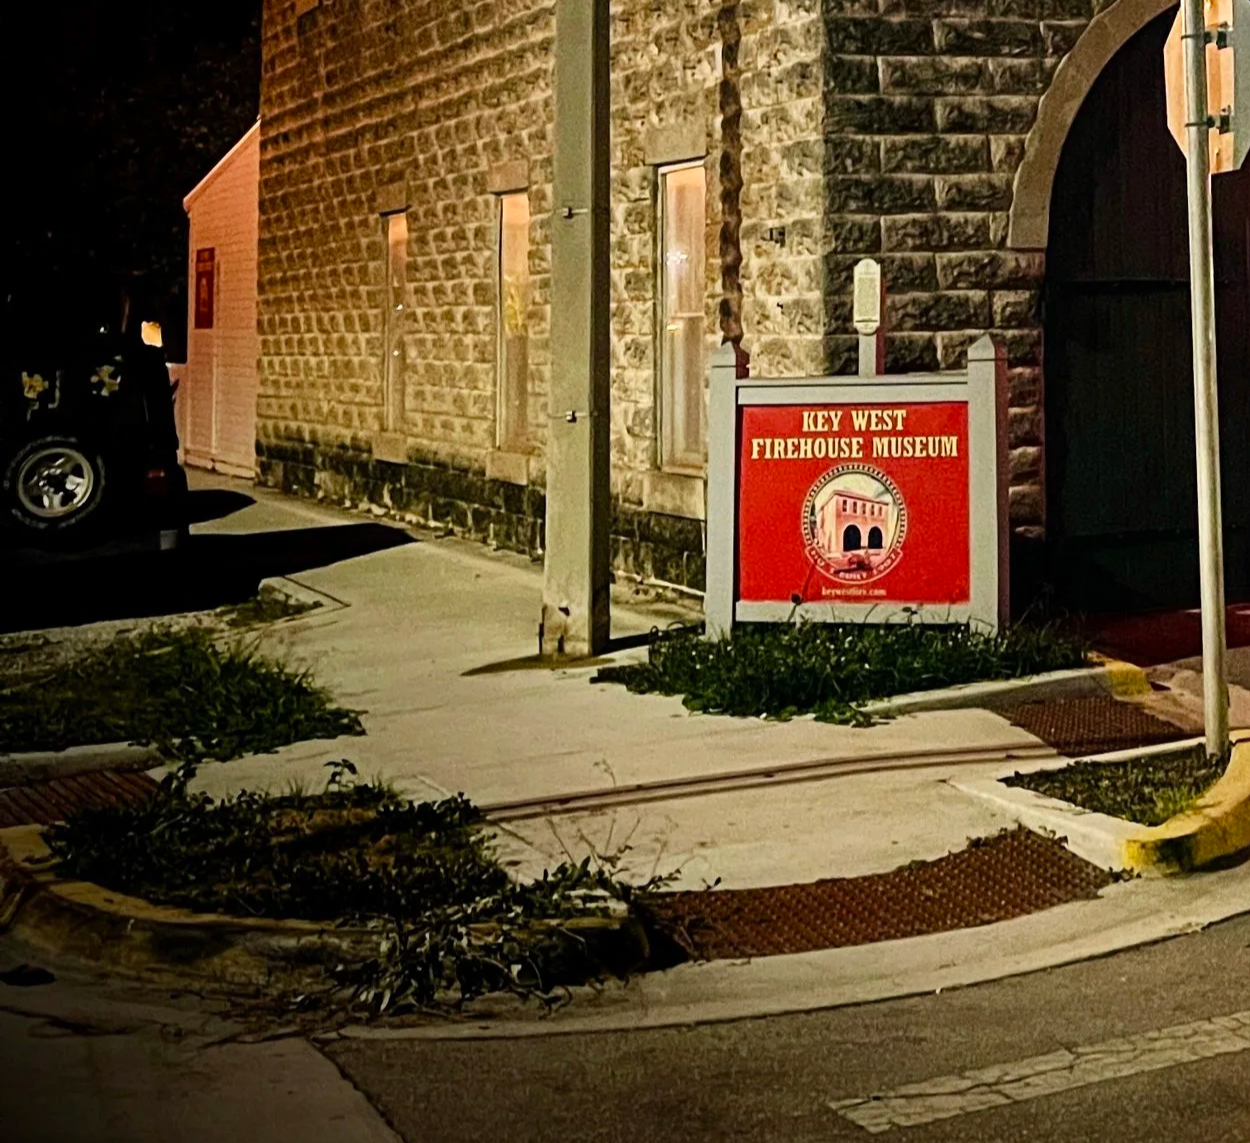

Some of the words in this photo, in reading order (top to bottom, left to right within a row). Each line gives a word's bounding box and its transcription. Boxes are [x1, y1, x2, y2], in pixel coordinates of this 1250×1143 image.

[802, 410, 843, 432] KEY
[852, 409, 907, 431] WEST
[751, 437, 863, 459] FIREHOUSE
[873, 436, 958, 458] MUSEUM
